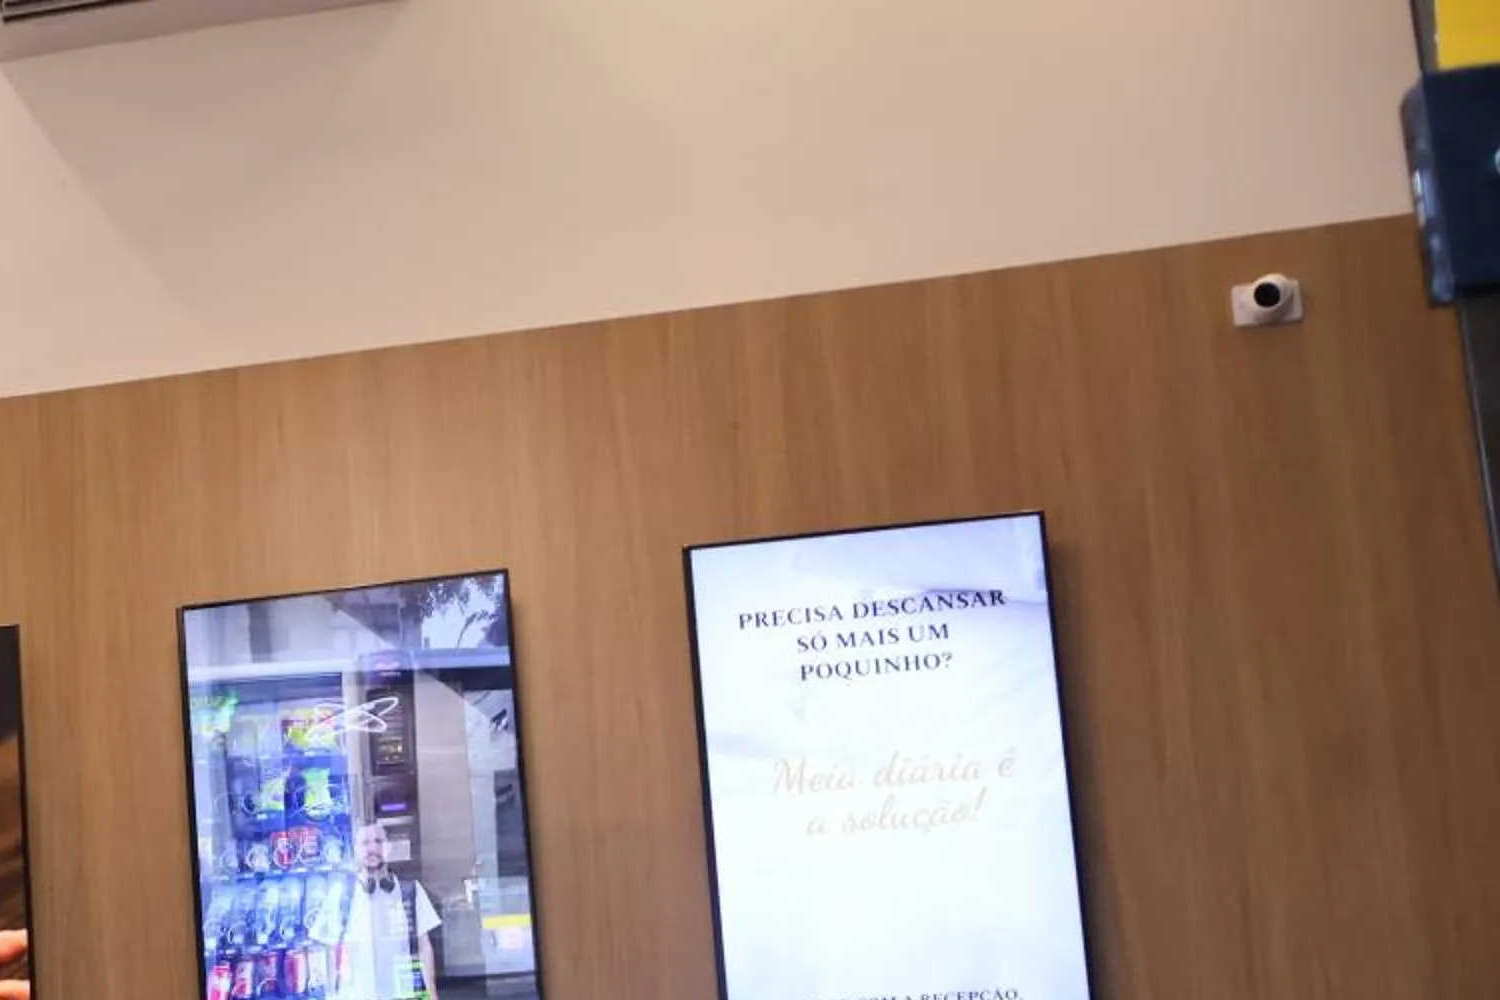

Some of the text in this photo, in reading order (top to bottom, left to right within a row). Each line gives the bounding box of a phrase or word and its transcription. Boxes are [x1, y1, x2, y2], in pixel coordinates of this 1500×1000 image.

[739, 589, 1006, 630] PRECISA DESCANSAR
[837, 627, 900, 648] MAIS
[908, 623, 948, 643] UM
[801, 651, 953, 682] POQUINHO?
[772, 745, 1017, 796] Meia diária é
[841, 786, 988, 835] solução!
